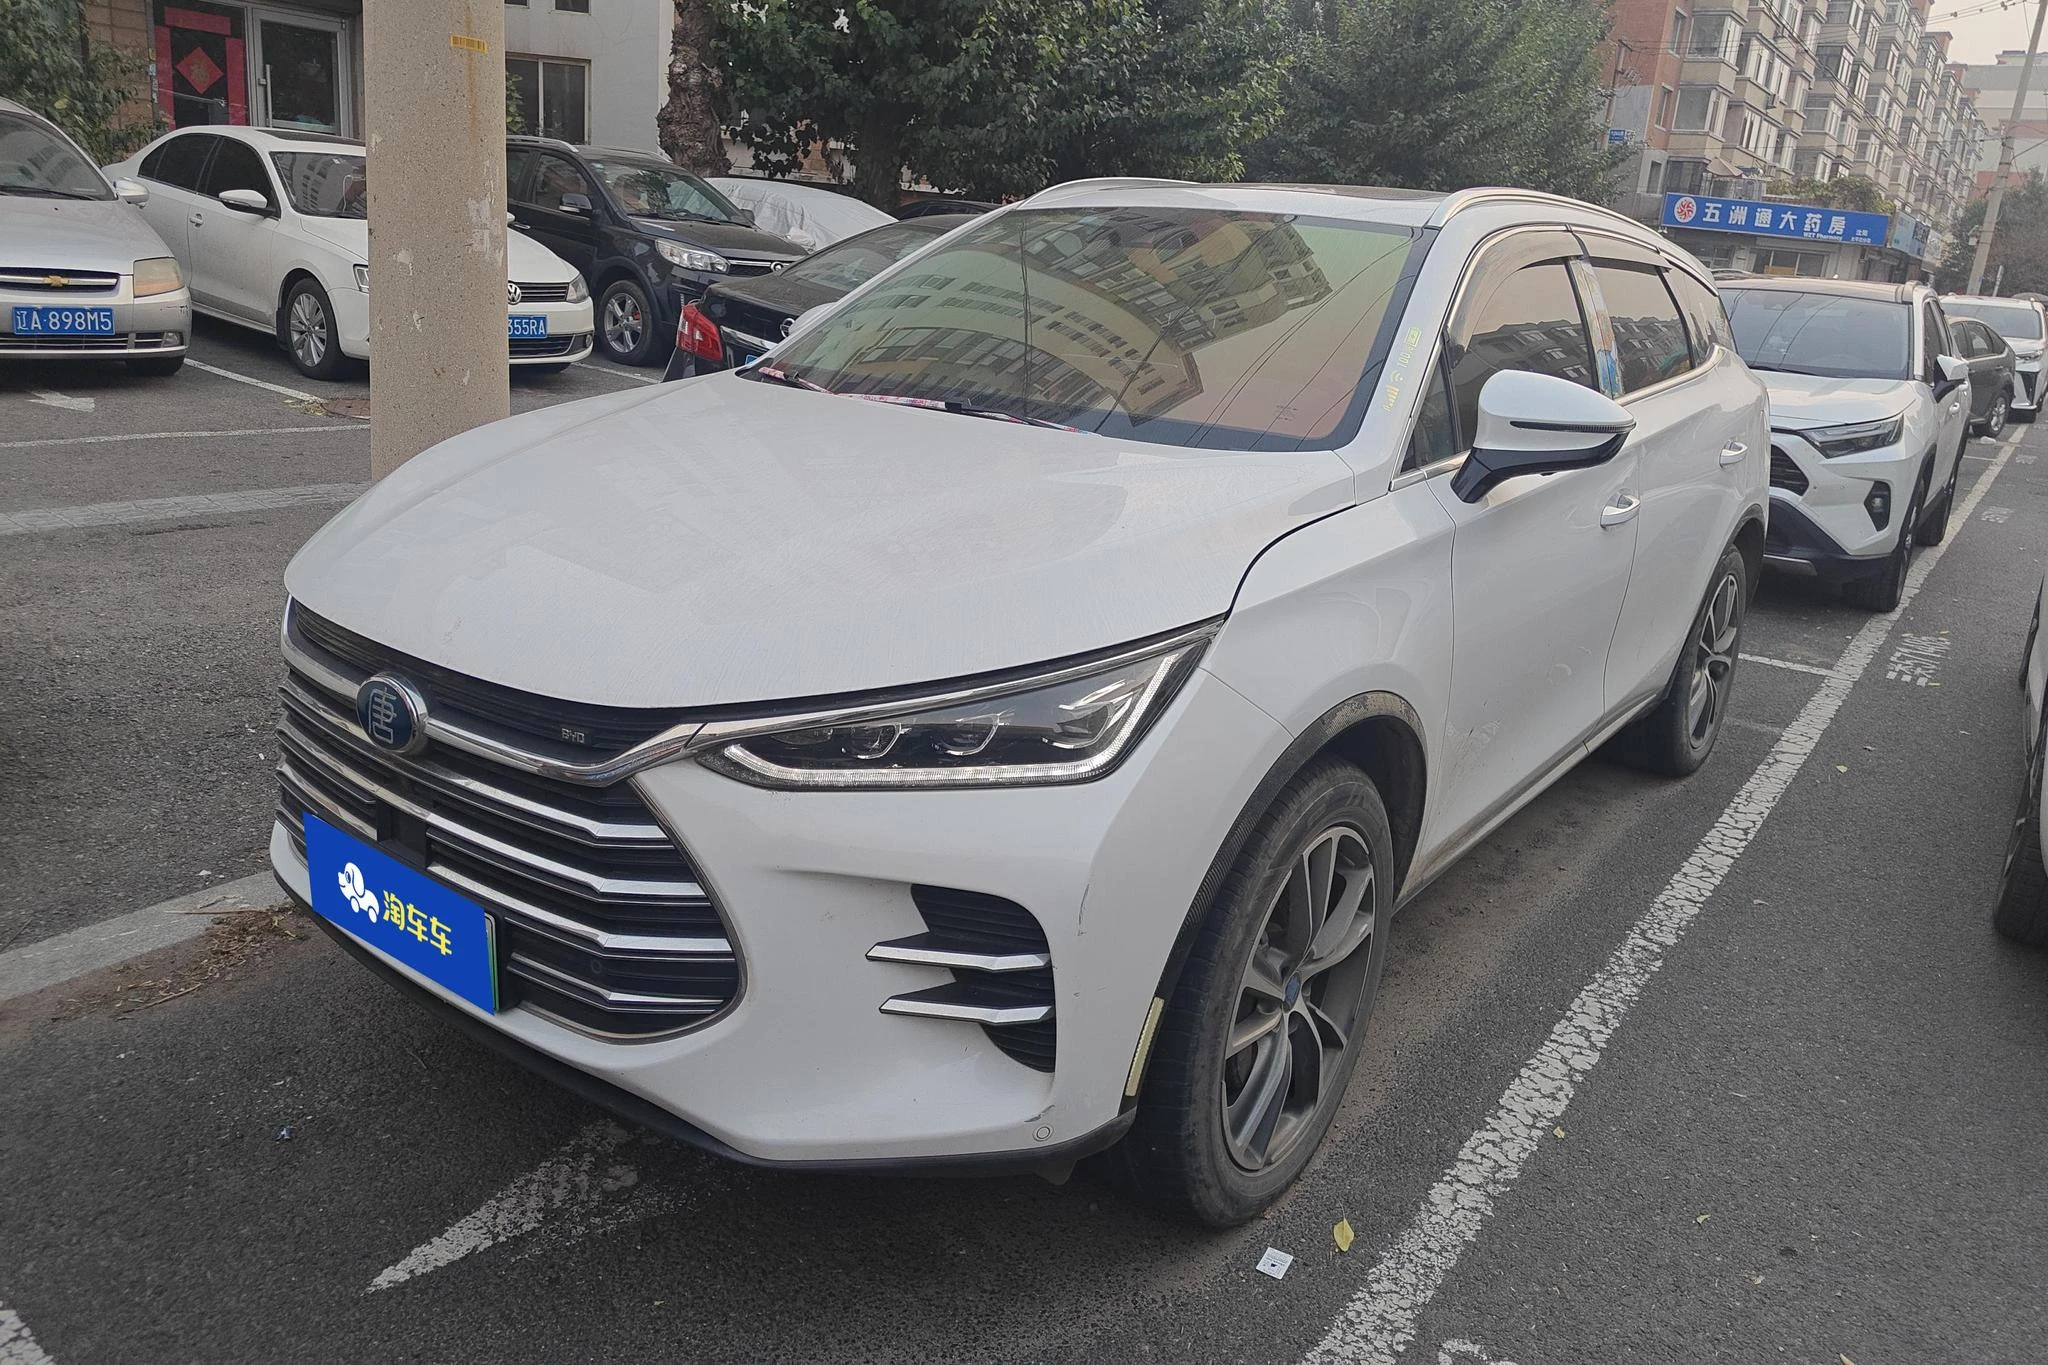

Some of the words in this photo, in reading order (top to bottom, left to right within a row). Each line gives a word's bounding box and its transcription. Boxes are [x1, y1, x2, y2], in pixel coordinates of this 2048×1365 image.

[1702, 202, 1846, 236] 五洲通大药房
[561, 727, 585, 744] BYD
